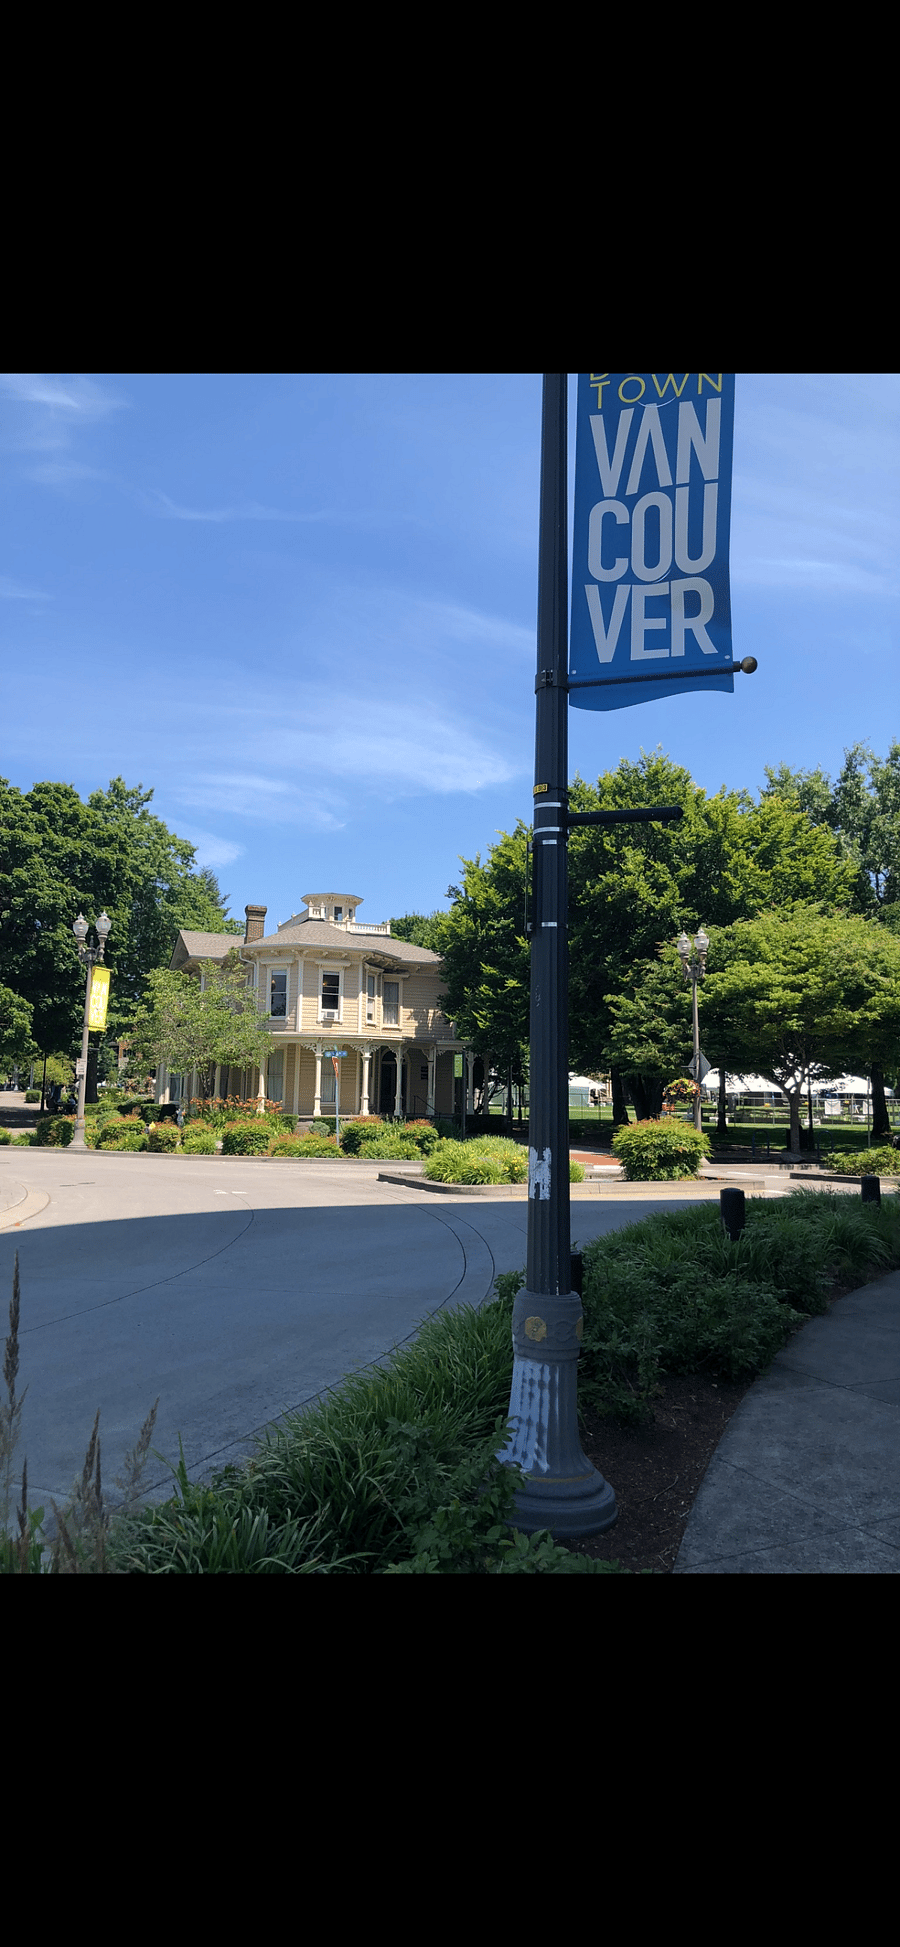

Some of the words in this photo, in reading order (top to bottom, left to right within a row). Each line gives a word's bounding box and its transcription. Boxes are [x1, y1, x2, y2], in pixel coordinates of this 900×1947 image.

[590, 373, 722, 409] TOWN
[589, 397, 721, 497] VAN
[588, 482, 718, 582] COU
[584, 577, 718, 663] VER
